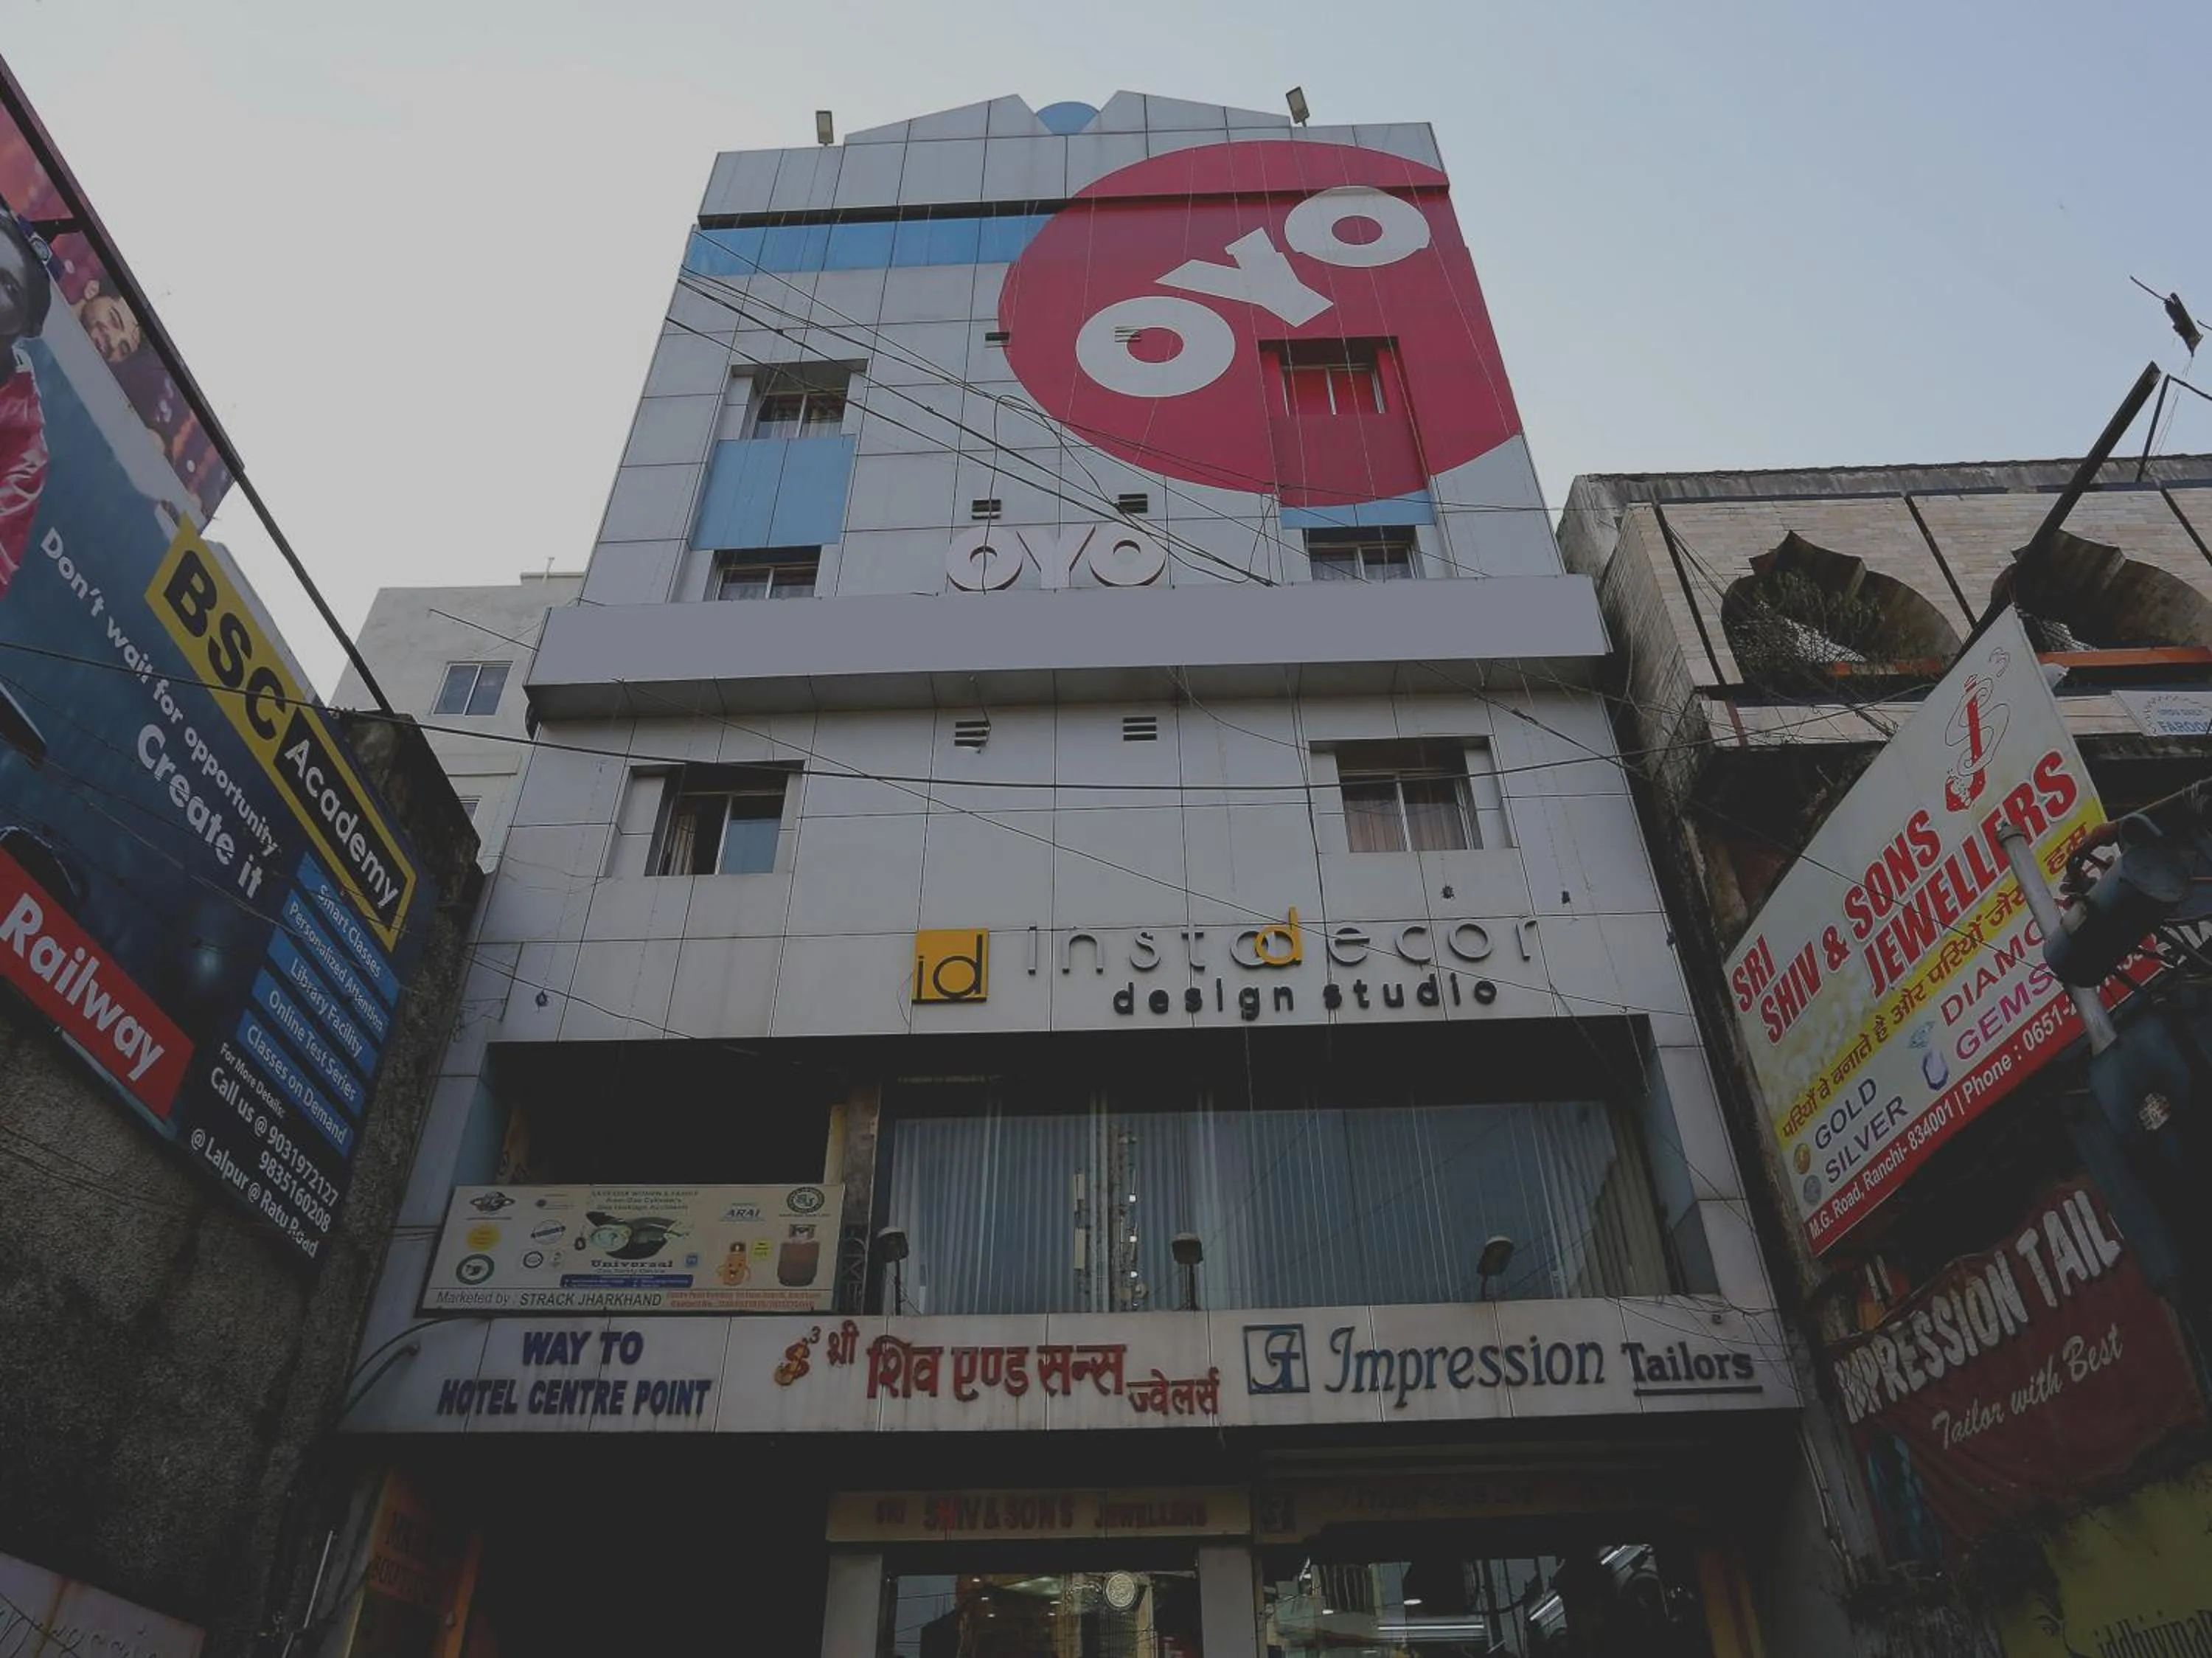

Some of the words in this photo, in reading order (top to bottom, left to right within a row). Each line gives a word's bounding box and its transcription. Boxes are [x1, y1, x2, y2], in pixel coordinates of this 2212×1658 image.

[1076, 186, 1430, 398] OYO
[41, 527, 104, 618] Don't
[107, 616, 153, 684] wait
[153, 679, 184, 724] for
[185, 726, 278, 857] opportunity
[164, 549, 285, 740] BSC
[137, 724, 235, 865] Create
[238, 854, 262, 899] it
[284, 738, 398, 909] Academy
[318, 884, 349, 933] Smart
[349, 926, 381, 978] Classes
[1761, 940, 1822, 1044] SHIV
[1821, 926, 1851, 972] &
[1844, 810, 1941, 940] SONS
[1863, 751, 2078, 999] JEWELLERS
[1, 893, 166, 1082] Railway
[289, 901, 347, 981] Personalized
[344, 977, 384, 1033] Attention
[291, 957, 329, 1016] Library
[327, 1004, 363, 1058] Facility
[1113, 977, 1294, 1021] design
[1324, 973, 1497, 1009] studio
[1732, 934, 1776, 1013] SRI
[1955, 962, 2054, 1061] GEMS
[220, 1042, 235, 1065] For
[234, 1058, 256, 1088] More
[247, 1025, 288, 1081] Classes
[288, 1074, 303, 1097] on
[304, 1089, 349, 1145] Demand
[270, 991, 304, 1041] Online
[303, 1030, 327, 1068] Test
[326, 1058, 357, 1102] Series
[211, 1067, 240, 1106] Call
[237, 1097, 254, 1123] us
[254, 1116, 268, 1137] @
[267, 1125, 339, 1207] 9031972127
[1809, 1211, 1834, 1240] M.G.
[1832, 1182, 1865, 1219] Road,
[1907, 1098, 1954, 1151] 834001
[1962, 1054, 2013, 1105] Phone
[1815, 1077, 1877, 1150] GOLD
[1825, 1096, 1908, 1184] SILVER
[191, 1128, 206, 1150] @
[205, 1137, 248, 1190] Lalpur
[247, 1182, 261, 1202] @
[260, 1189, 289, 1229] Ratu
[287, 1218, 319, 1258] Road
[2016, 1190, 2122, 1308] TAIL
[495, 1292, 510, 1306] by
[519, 1293, 574, 1305] STRACK
[578, 1293, 662, 1306] JHARKHAND
[522, 1331, 591, 1366] WAY
[600, 1331, 644, 1366] TO
[437, 1379, 518, 1416] HOTEL
[527, 1380, 627, 1415] CENTRE
[632, 1380, 713, 1416] POINT
[866, 1334, 944, 1398] शिव
[1037, 1343, 1127, 1396] सन्स
[1324, 1326, 1605, 1408] Impression
[1621, 1341, 1754, 1384] Tailors
[1932, 1400, 2005, 1450] Tailor
[2011, 1353, 2063, 1415] with
[2063, 1323, 2124, 1383] Best
